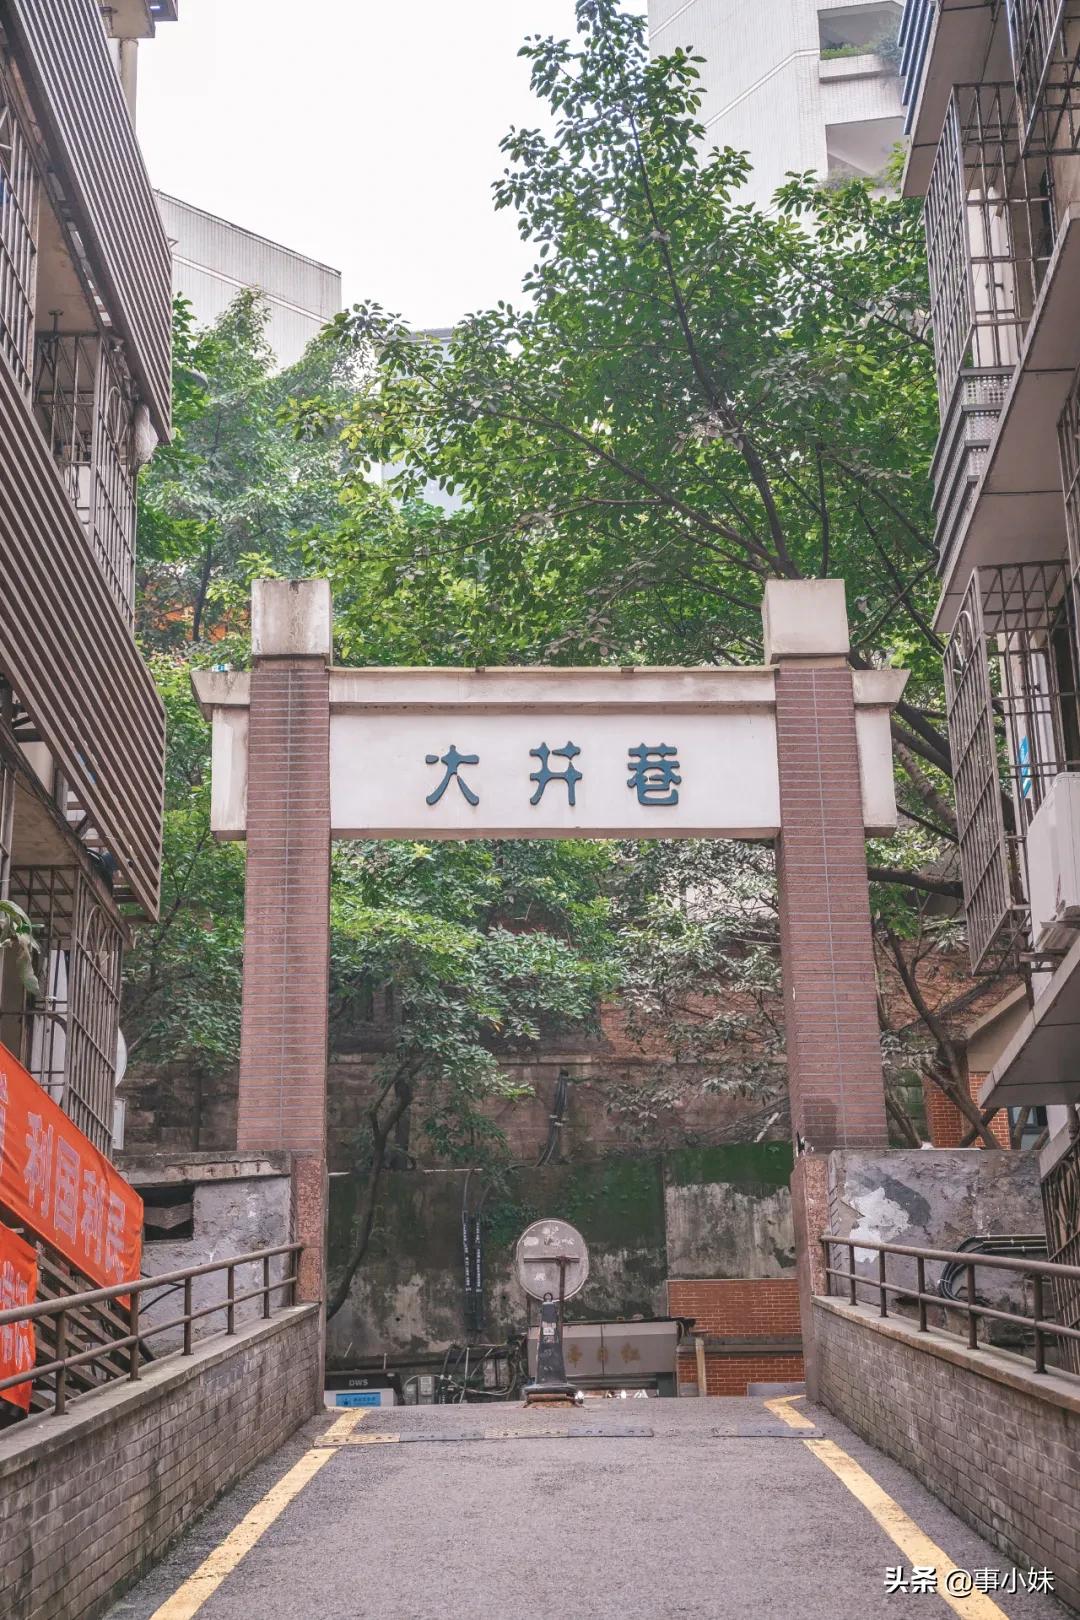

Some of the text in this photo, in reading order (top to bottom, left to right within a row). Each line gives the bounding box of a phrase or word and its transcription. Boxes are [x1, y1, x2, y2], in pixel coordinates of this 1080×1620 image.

[425, 741, 682, 806] 大井巷
[24, 1111, 126, 1283] 利国利民
